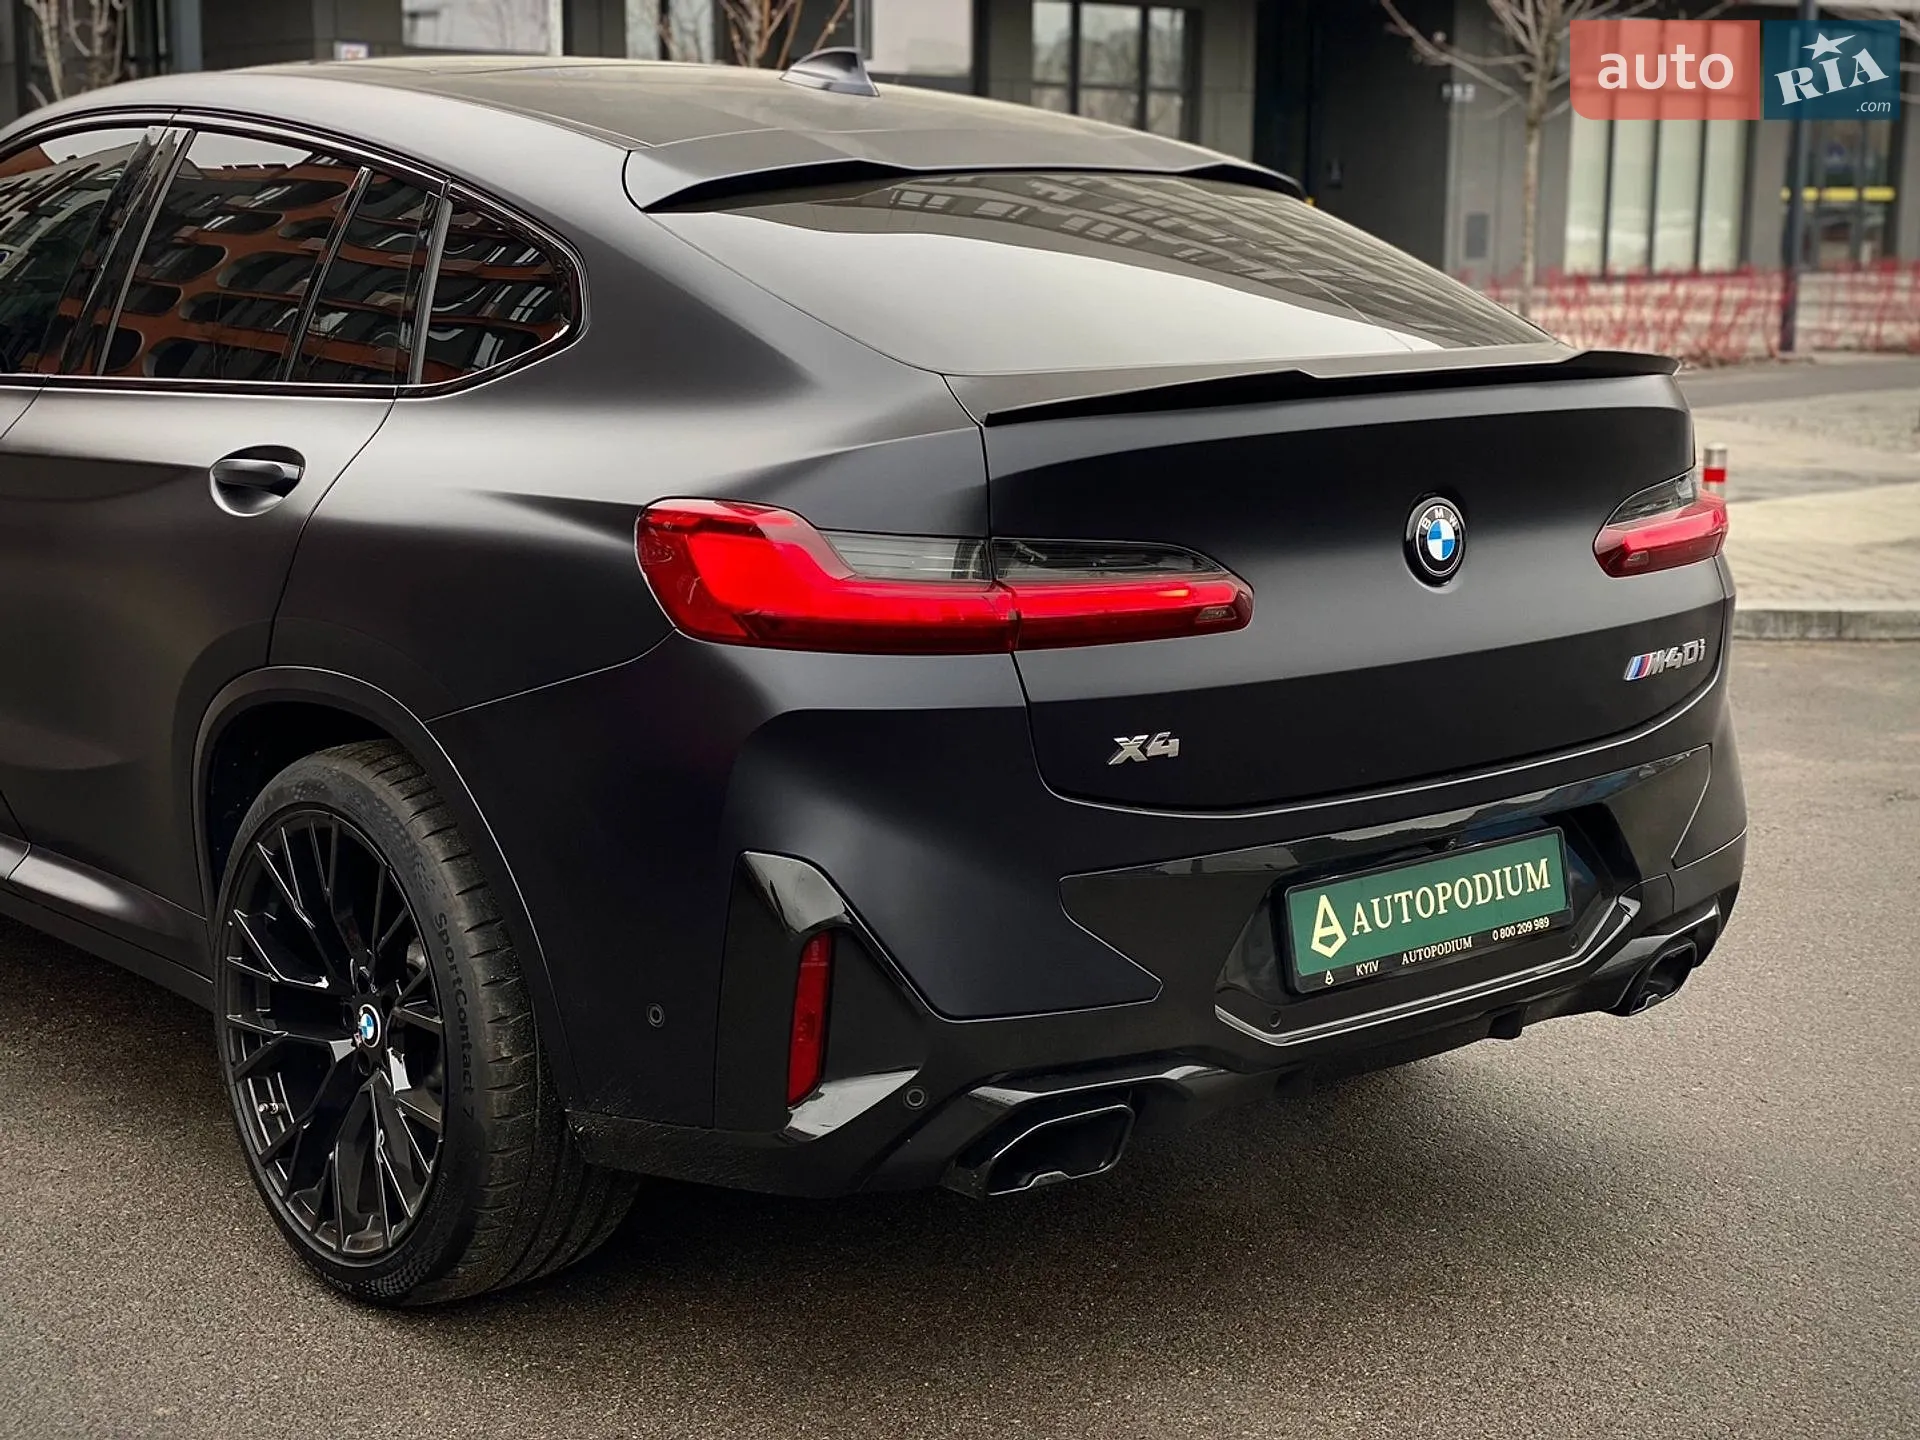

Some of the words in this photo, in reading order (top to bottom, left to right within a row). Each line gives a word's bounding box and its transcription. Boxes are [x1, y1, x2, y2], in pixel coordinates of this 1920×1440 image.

[1421, 508, 1459, 531] BMW
[1107, 731, 1180, 765] X4
[1351, 858, 1551, 936] AUTOPODIUM
[1355, 960, 1379, 976] KYIV
[1401, 936, 1472, 965] AUTOPODIUM
[1492, 929, 1498, 941] 0
[1500, 926, 1516, 939] 800
[1517, 920, 1533, 935] 209
[434, 911, 475, 1096] SportContact
